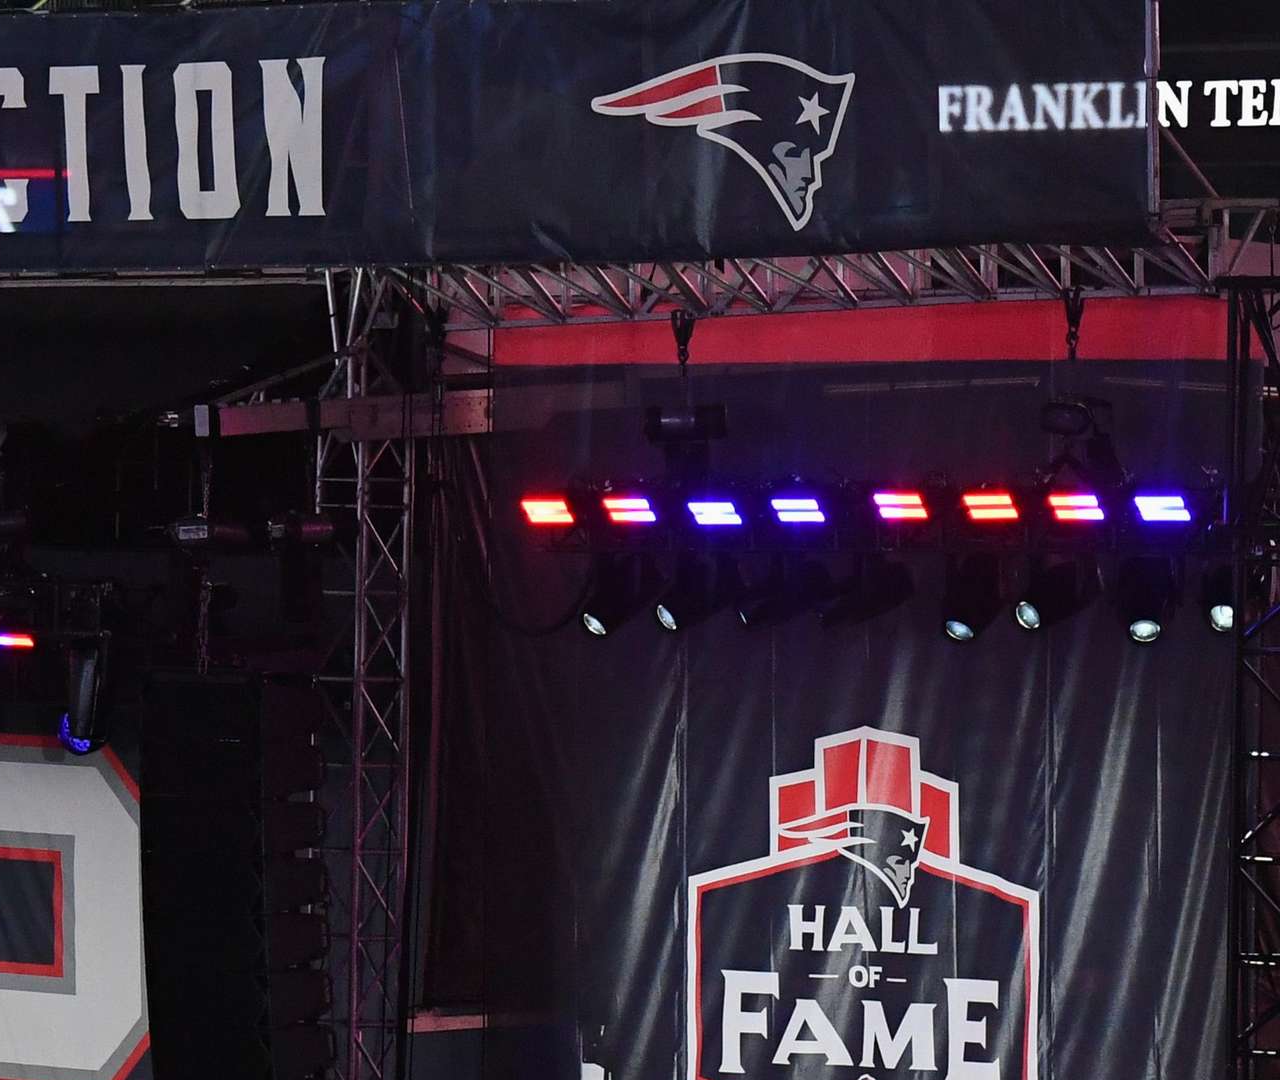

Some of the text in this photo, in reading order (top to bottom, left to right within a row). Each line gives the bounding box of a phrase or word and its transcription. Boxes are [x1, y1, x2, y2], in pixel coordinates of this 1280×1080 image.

[938, 79, 1280, 133] FRANKLIN TE
[787, 903, 938, 956] HALL
[848, 965, 883, 989] OF
